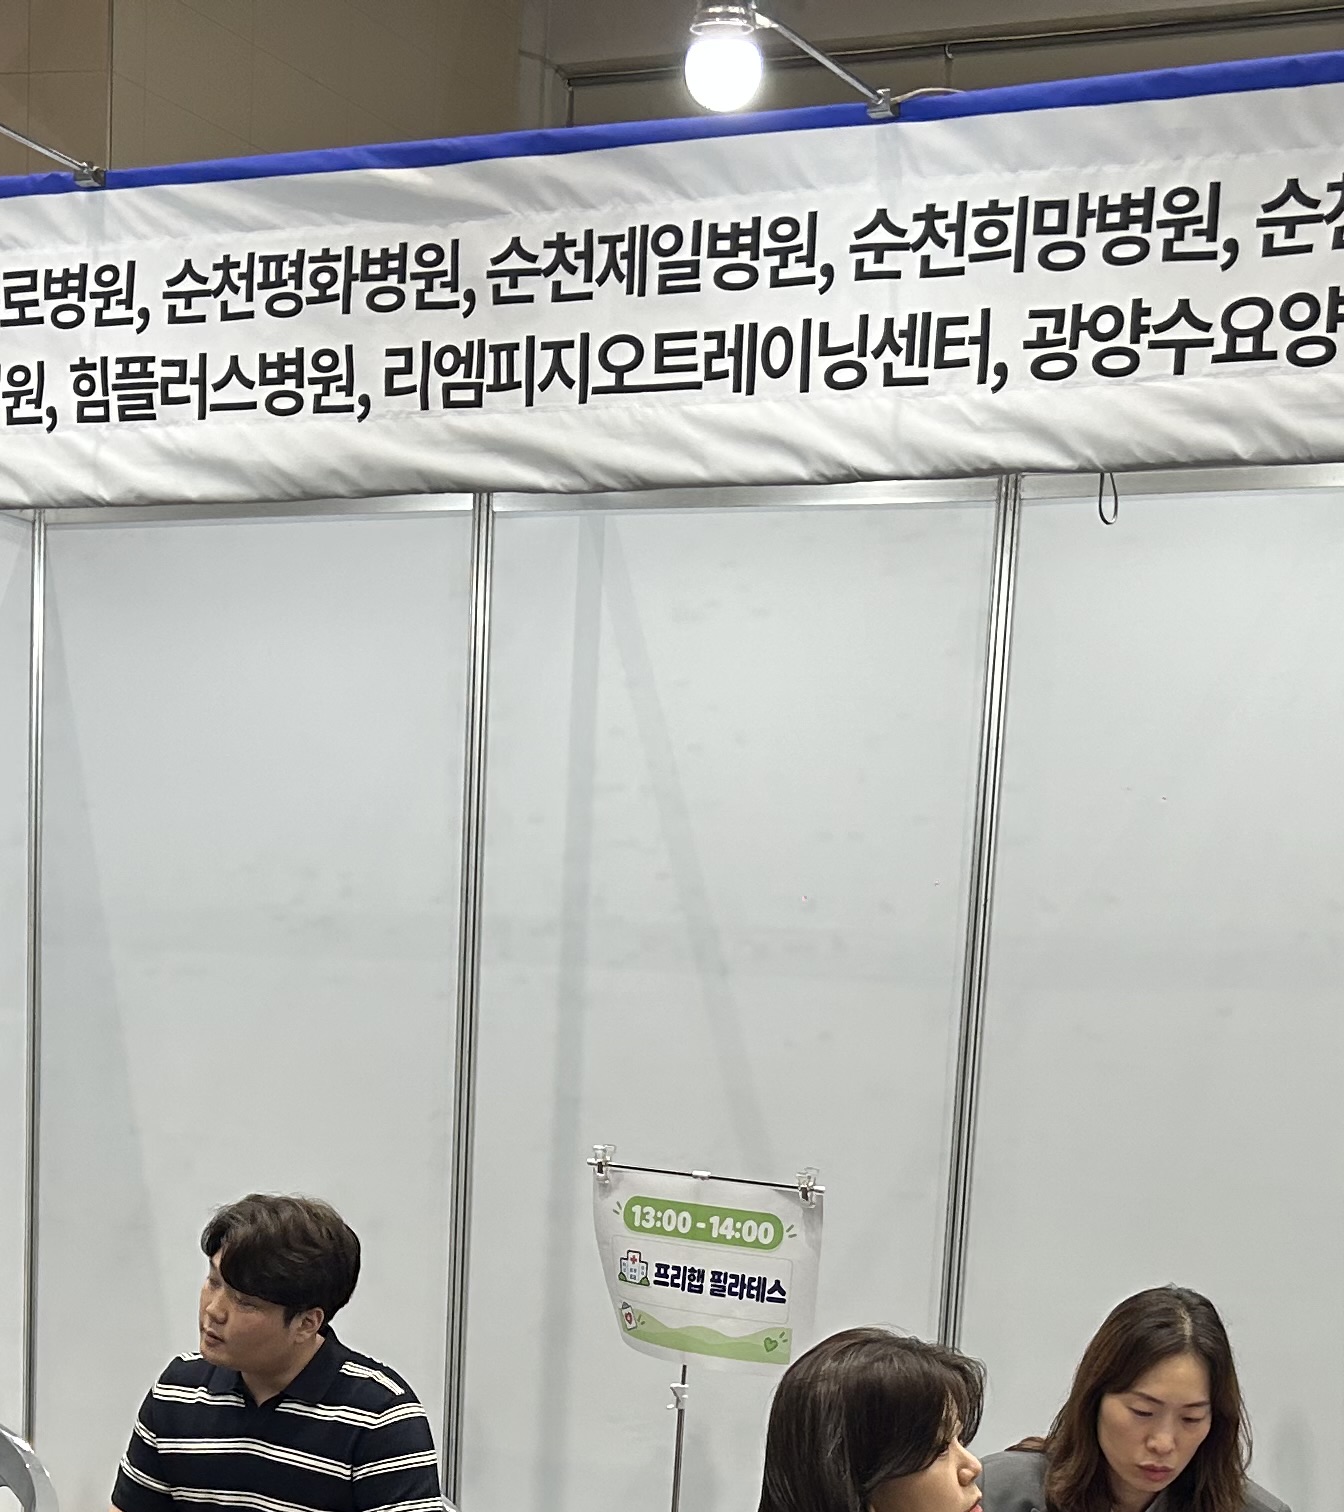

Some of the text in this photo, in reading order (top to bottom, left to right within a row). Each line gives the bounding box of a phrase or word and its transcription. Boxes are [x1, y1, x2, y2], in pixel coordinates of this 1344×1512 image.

[164, 239, 475, 325] 순천평화병원,
[485, 210, 835, 305] 순천제일병원,
[848, 182, 1238, 281] 순천희망병원,
[69, 344, 371, 424] 힘플러스병원,
[385, 307, 1008, 410] 리엠피지오트레이닝센터,
[631, 1205, 692, 1234] 13:00
[709, 1216, 775, 1244] 14:00
[653, 1263, 787, 1304] 프리햅 필라테스
